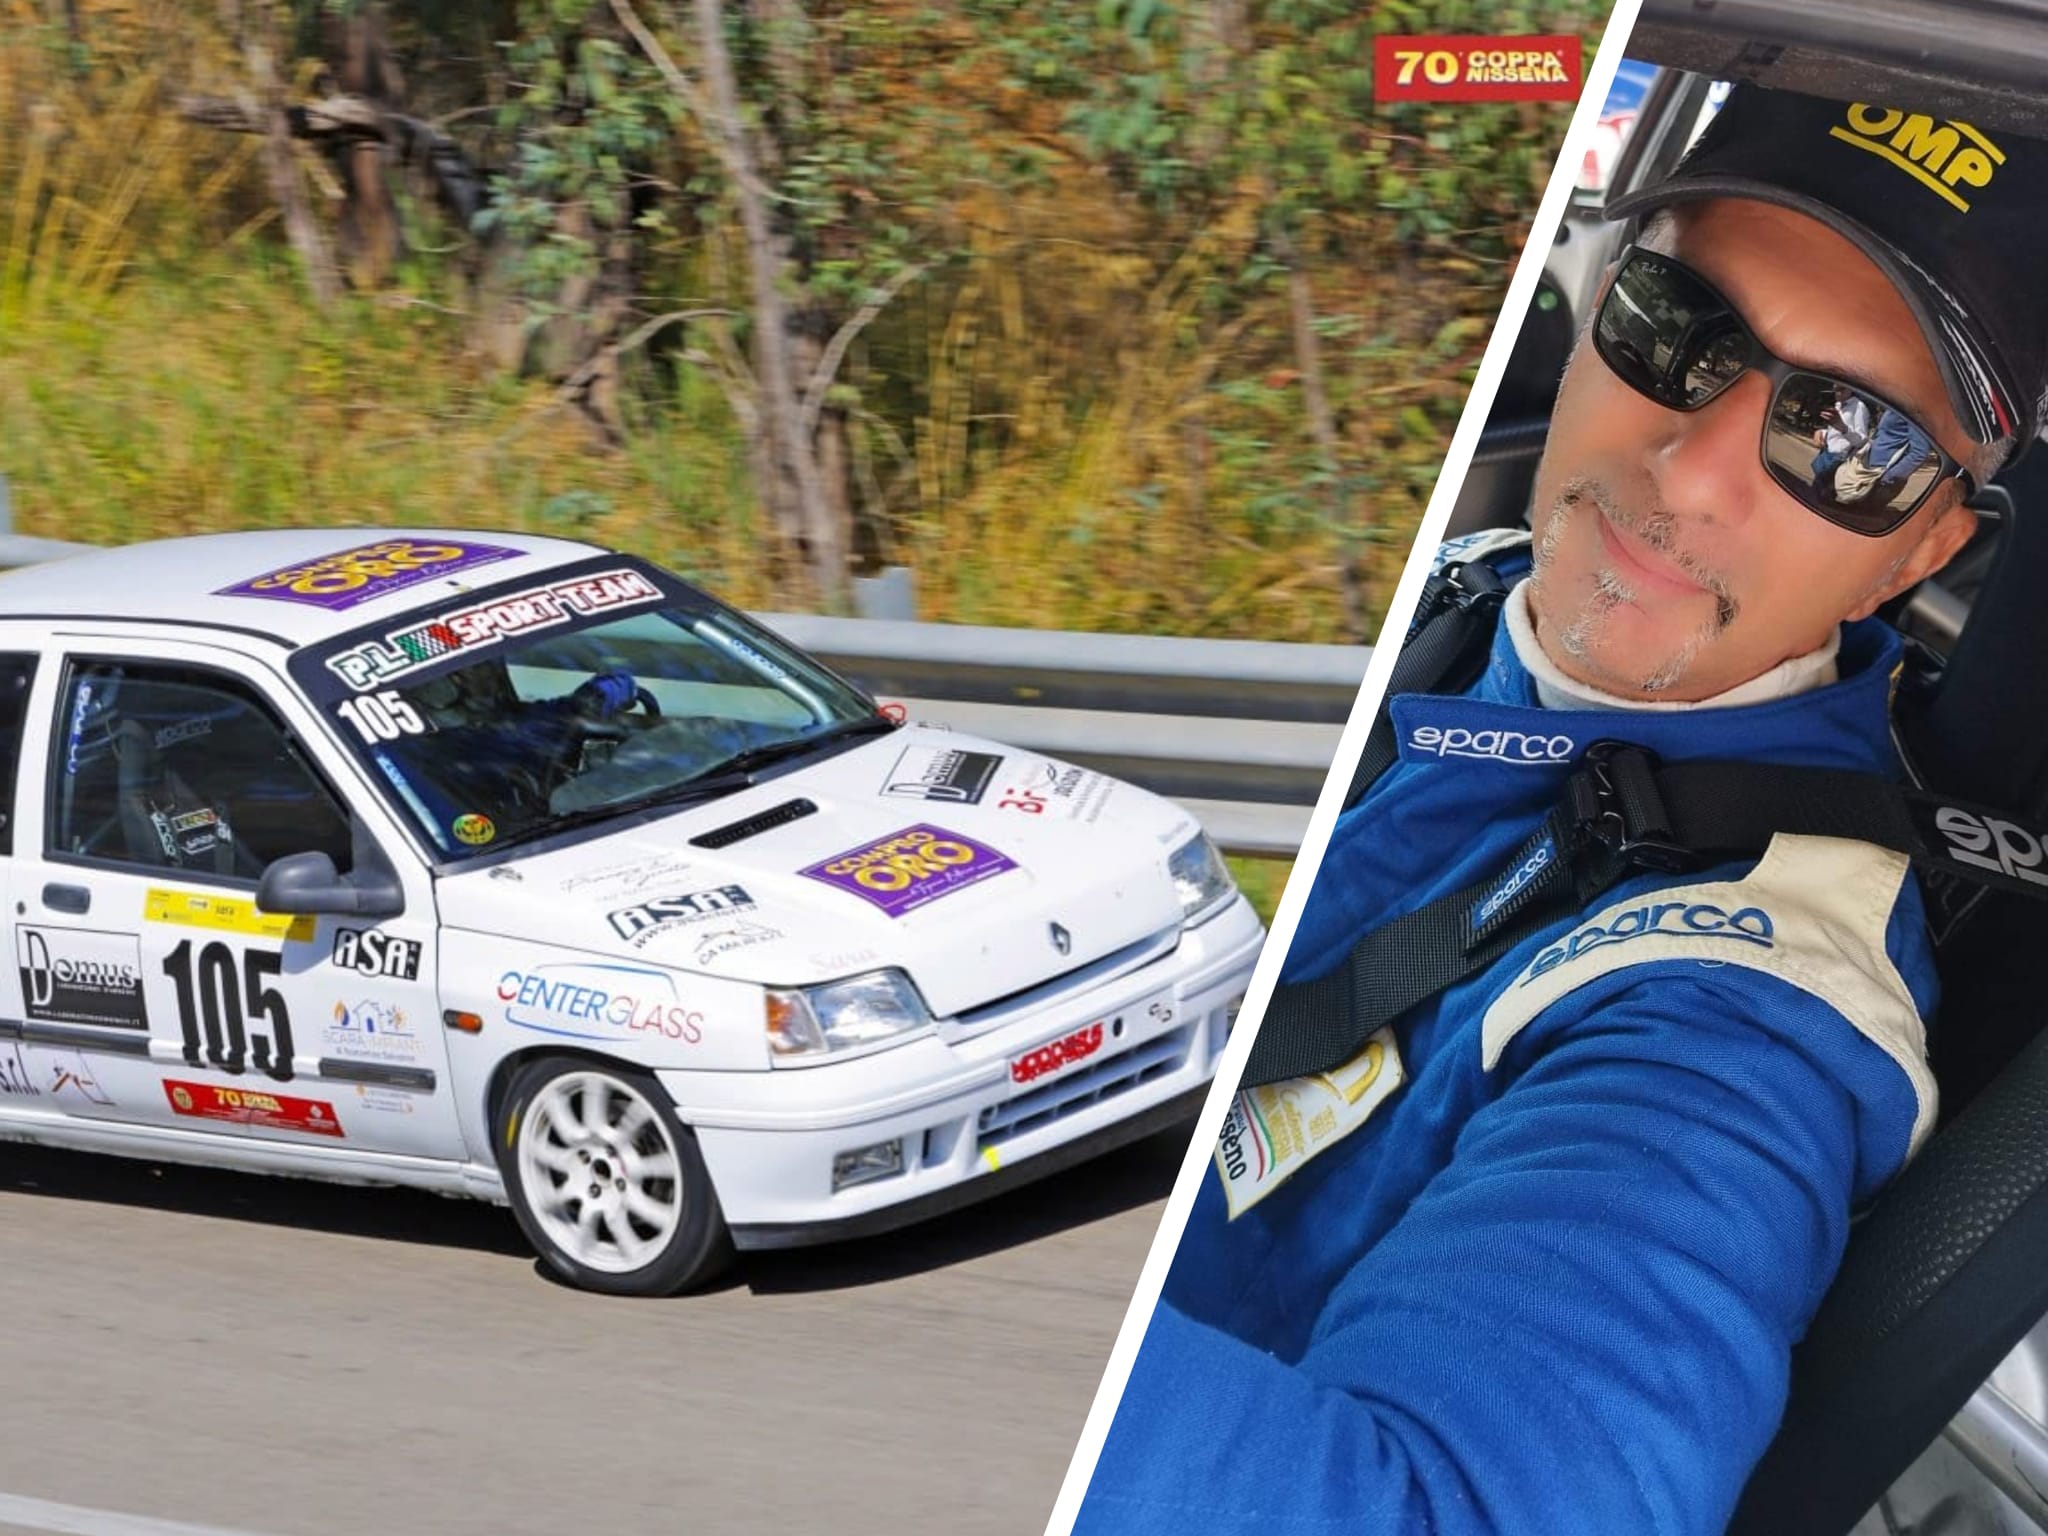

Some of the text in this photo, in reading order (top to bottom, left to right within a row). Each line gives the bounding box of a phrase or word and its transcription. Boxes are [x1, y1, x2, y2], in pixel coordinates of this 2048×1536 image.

[1847, 103, 1993, 187] OMP
[290, 546, 464, 594] ORO
[447, 592, 561, 644] SPORT
[554, 573, 655, 609] TEAM
[338, 691, 424, 745] 105
[1412, 726, 1574, 763] sparco
[854, 841, 974, 891] ORO
[1936, 807, 2048, 877] sp
[612, 888, 725, 939] ASA
[1480, 846, 1549, 917] sparco
[24, 930, 136, 1006] Domus
[335, 929, 408, 977] ASA
[1527, 901, 1774, 979] sparco
[162, 938, 295, 1082] 105
[497, 971, 704, 1044] CENTERGLASS
